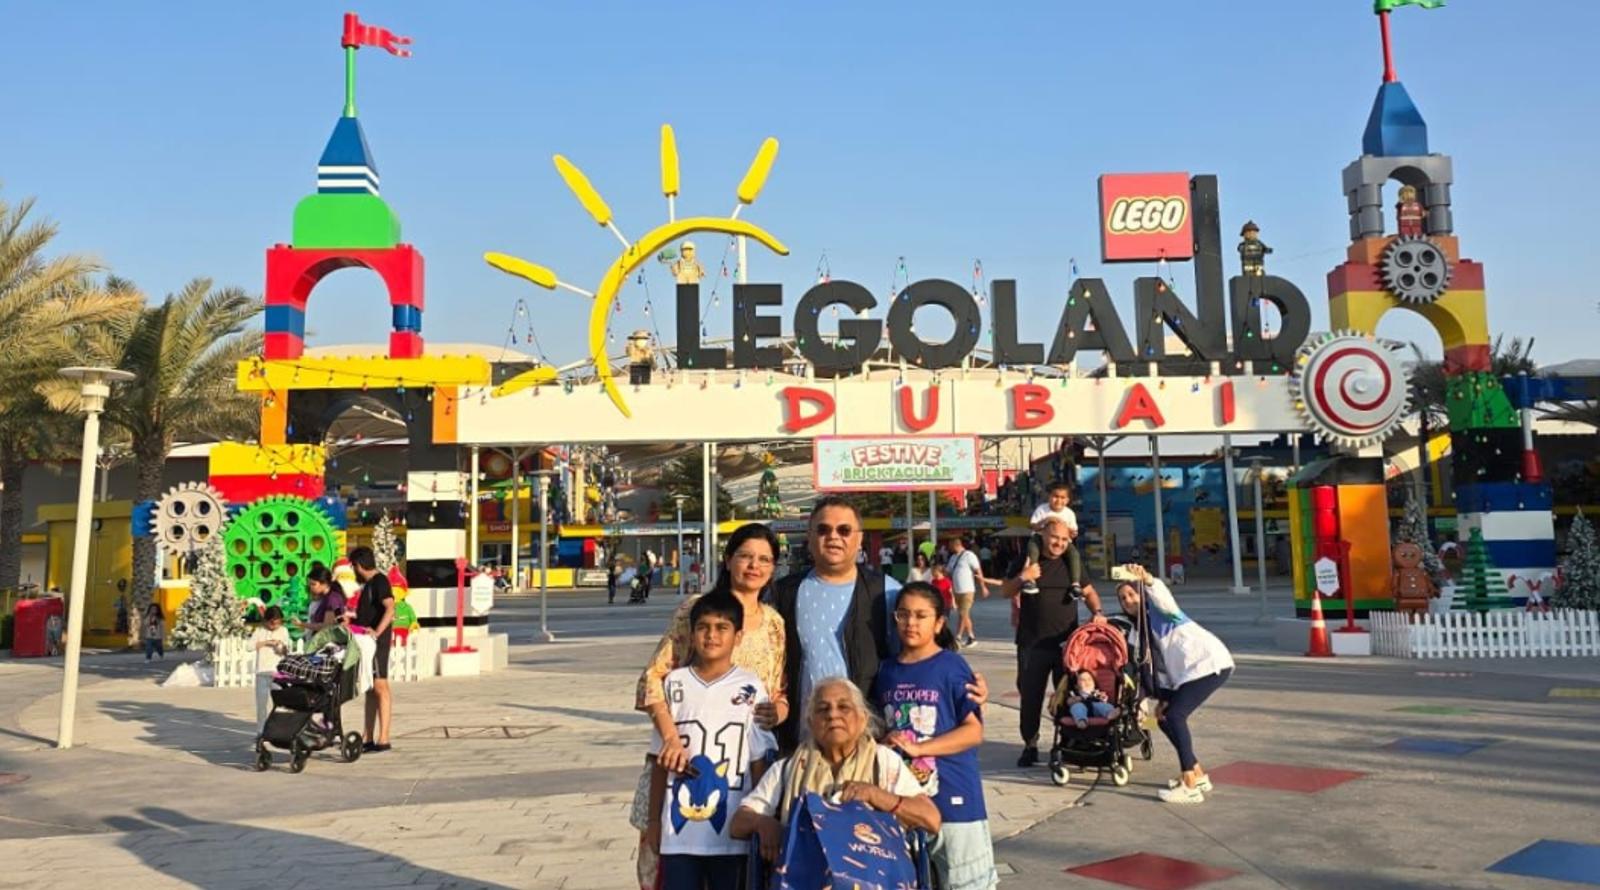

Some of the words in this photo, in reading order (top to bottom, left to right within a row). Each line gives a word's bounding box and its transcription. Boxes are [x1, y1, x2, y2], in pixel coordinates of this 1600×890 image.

[1109, 198, 1186, 233] LEGO
[676, 276, 1311, 372] LEGOLAND
[783, 384, 1235, 432] DUBAI
[852, 443, 941, 466] FESTIVE
[894, 689, 939, 702] COOPER
